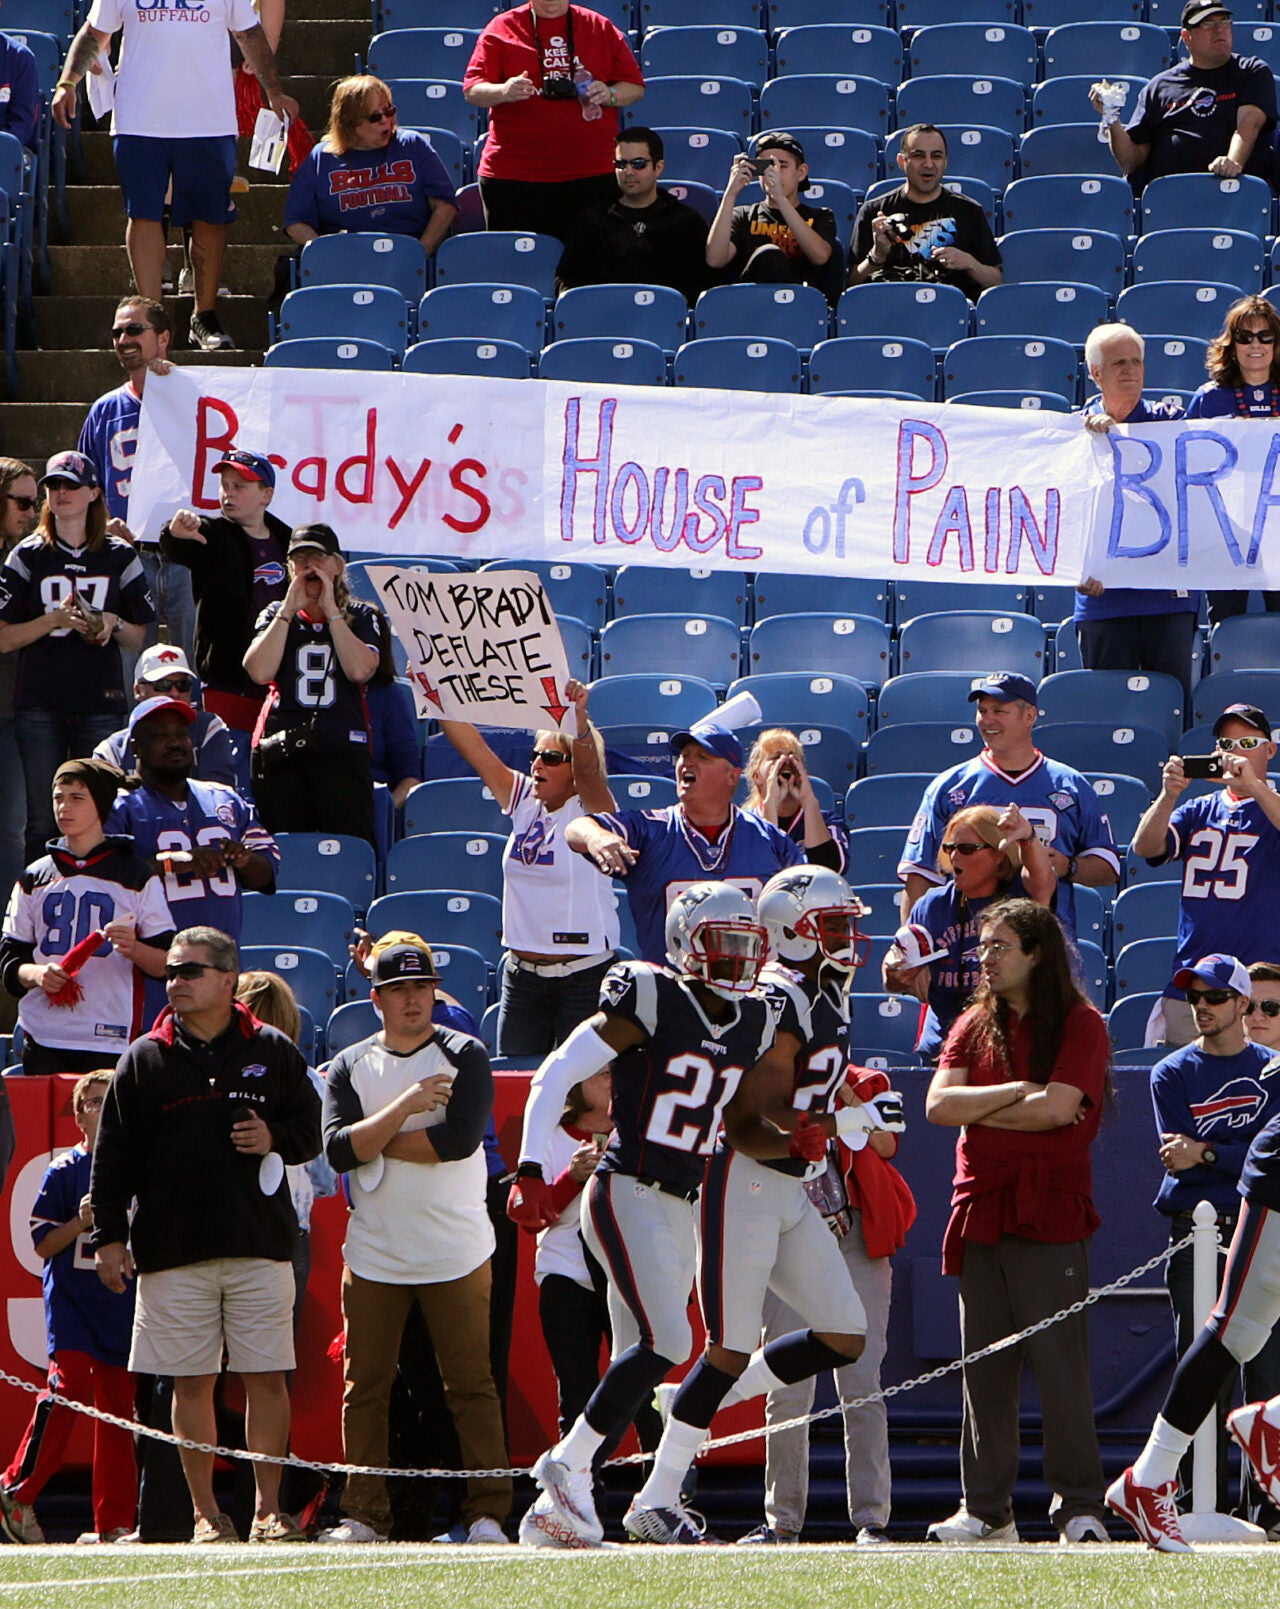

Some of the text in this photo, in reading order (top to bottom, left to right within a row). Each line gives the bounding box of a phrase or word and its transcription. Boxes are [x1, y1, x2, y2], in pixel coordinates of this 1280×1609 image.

[137, 9, 210, 23] BUFFALO
[191, 396, 492, 534] Bady's
[802, 477, 867, 560] of
[892, 417, 1062, 577] PAIN
[40, 574, 111, 638] 87
[384, 574, 551, 631] TOM BRADY
[296, 644, 337, 708] 8
[412, 627, 552, 674] DEFLATE
[438, 672, 528, 705] THESE
[1182, 826, 1261, 901] 25
[40, 891, 116, 958] 80
[645, 1050, 745, 1157] 21
